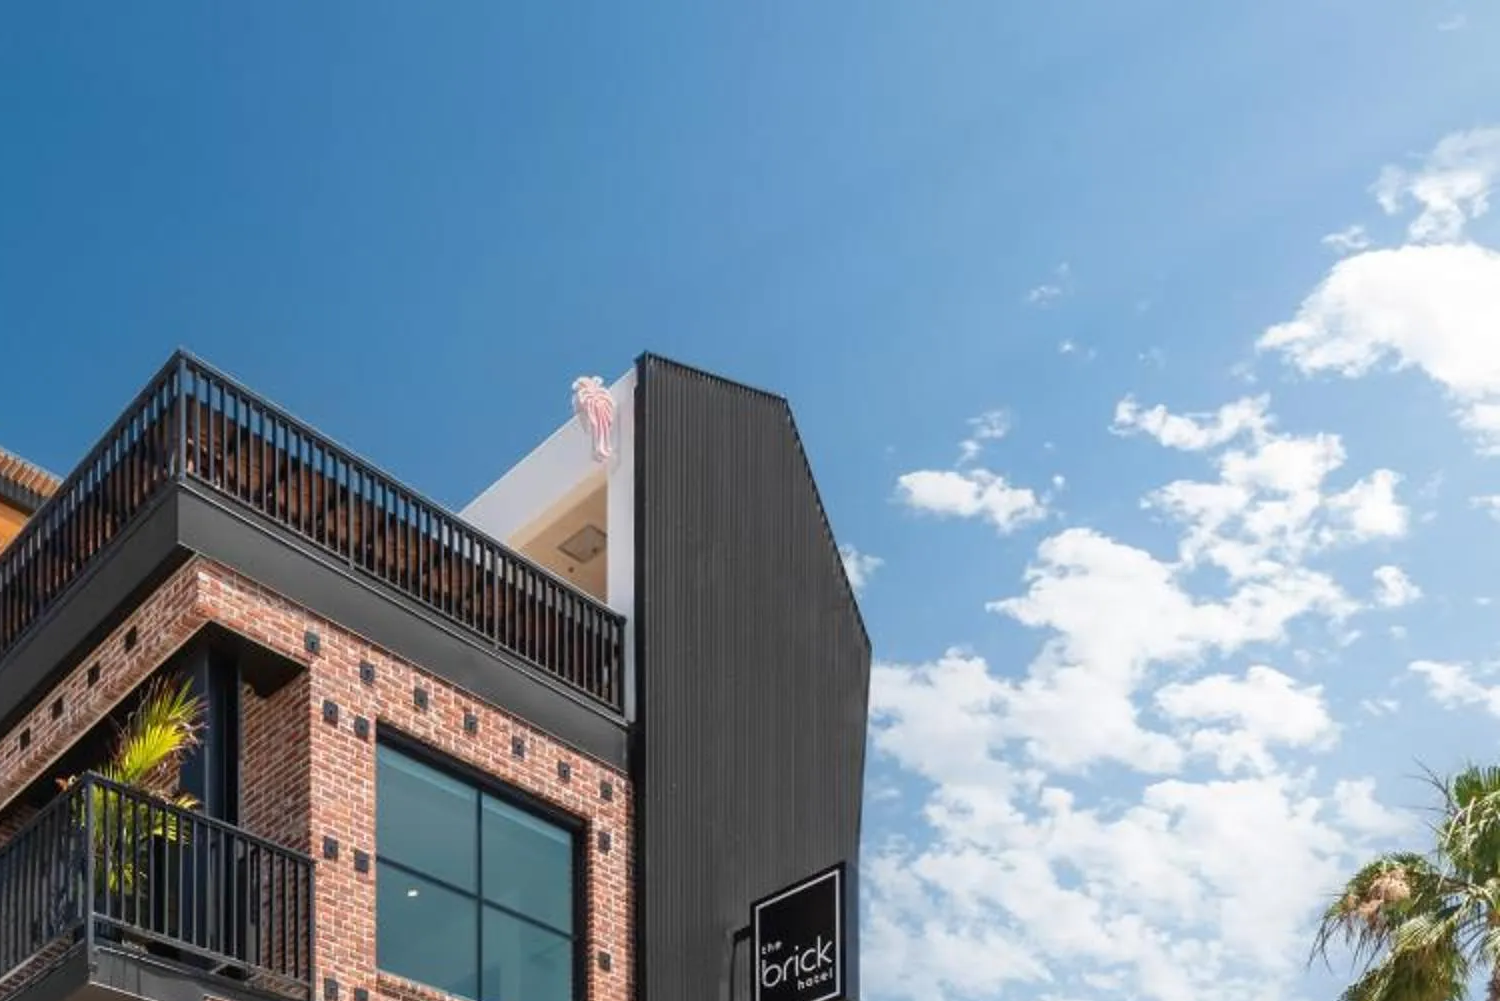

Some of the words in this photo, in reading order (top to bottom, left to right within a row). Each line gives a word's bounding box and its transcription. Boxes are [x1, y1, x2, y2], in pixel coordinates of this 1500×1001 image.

[762, 941, 782, 955] the
[762, 935, 833, 987] brick
[797, 968, 833, 991] hotel
